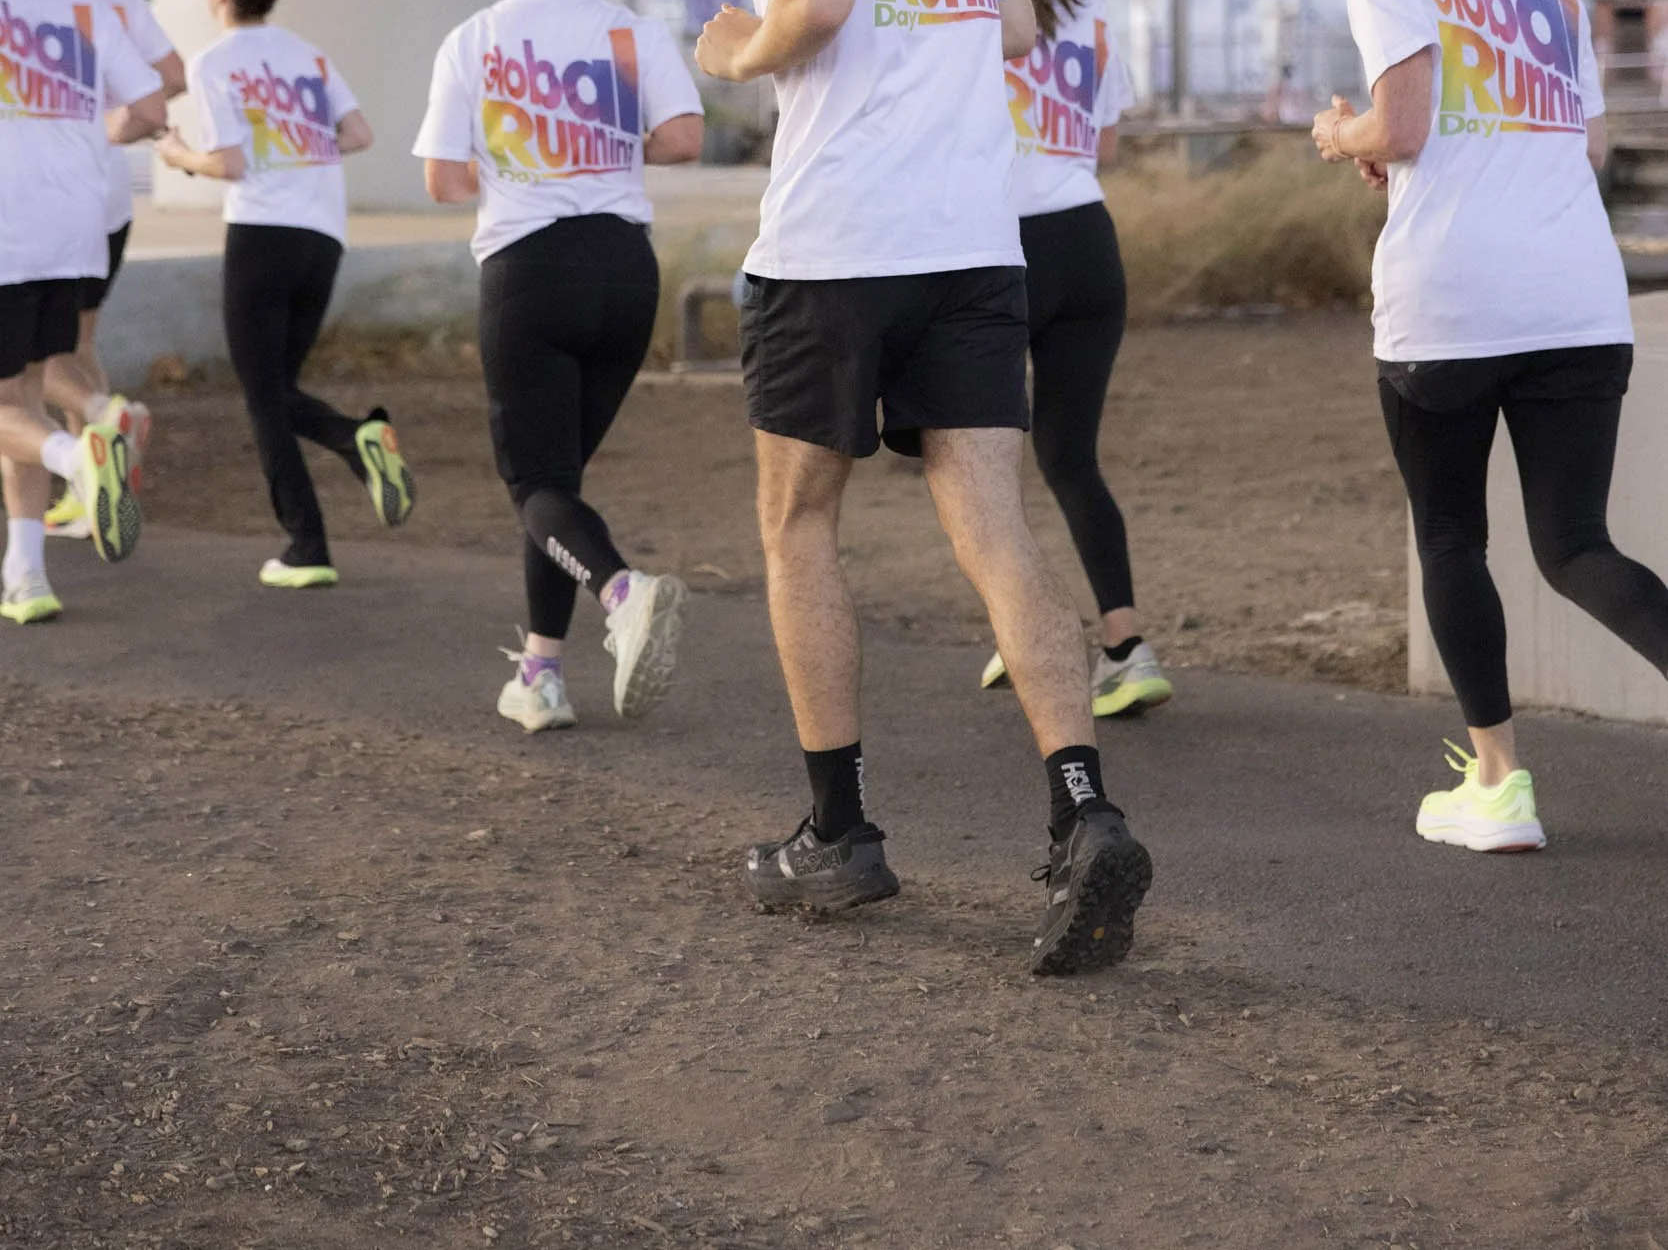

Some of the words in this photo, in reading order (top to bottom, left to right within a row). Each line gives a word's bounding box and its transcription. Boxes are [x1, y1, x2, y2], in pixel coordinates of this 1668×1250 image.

[0, 0, 96, 89] bal
[874, 2, 917, 32] Day
[0, 52, 96, 123] unnin
[1009, 17, 1108, 115] bal
[1438, 20, 1586, 127] Runnin
[1439, 113, 1496, 138] Day
[793, 845, 842, 877] HOKA
